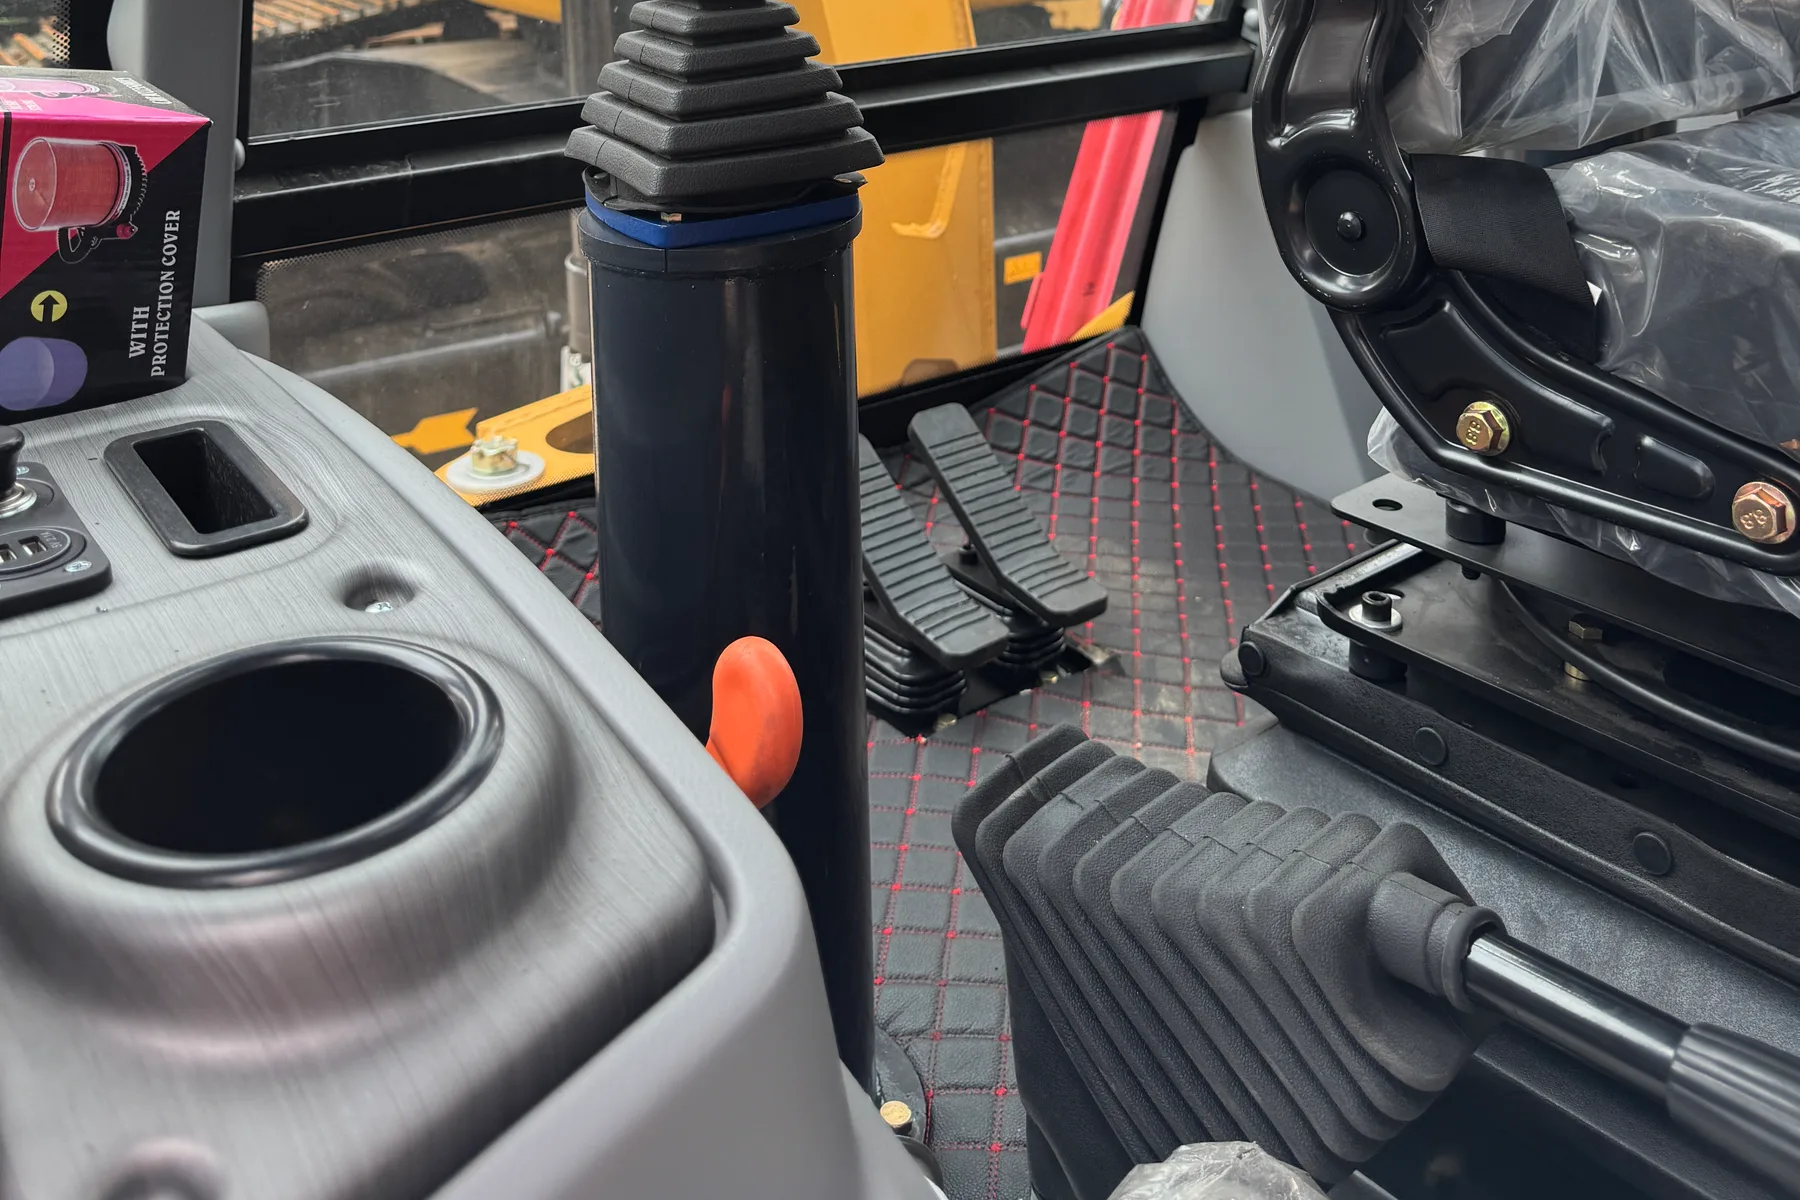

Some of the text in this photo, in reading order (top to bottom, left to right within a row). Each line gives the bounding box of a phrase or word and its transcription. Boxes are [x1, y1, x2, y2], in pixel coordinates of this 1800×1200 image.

[129, 305, 151, 359] WITH
[151, 209, 181, 377] PROTECTION COVER
